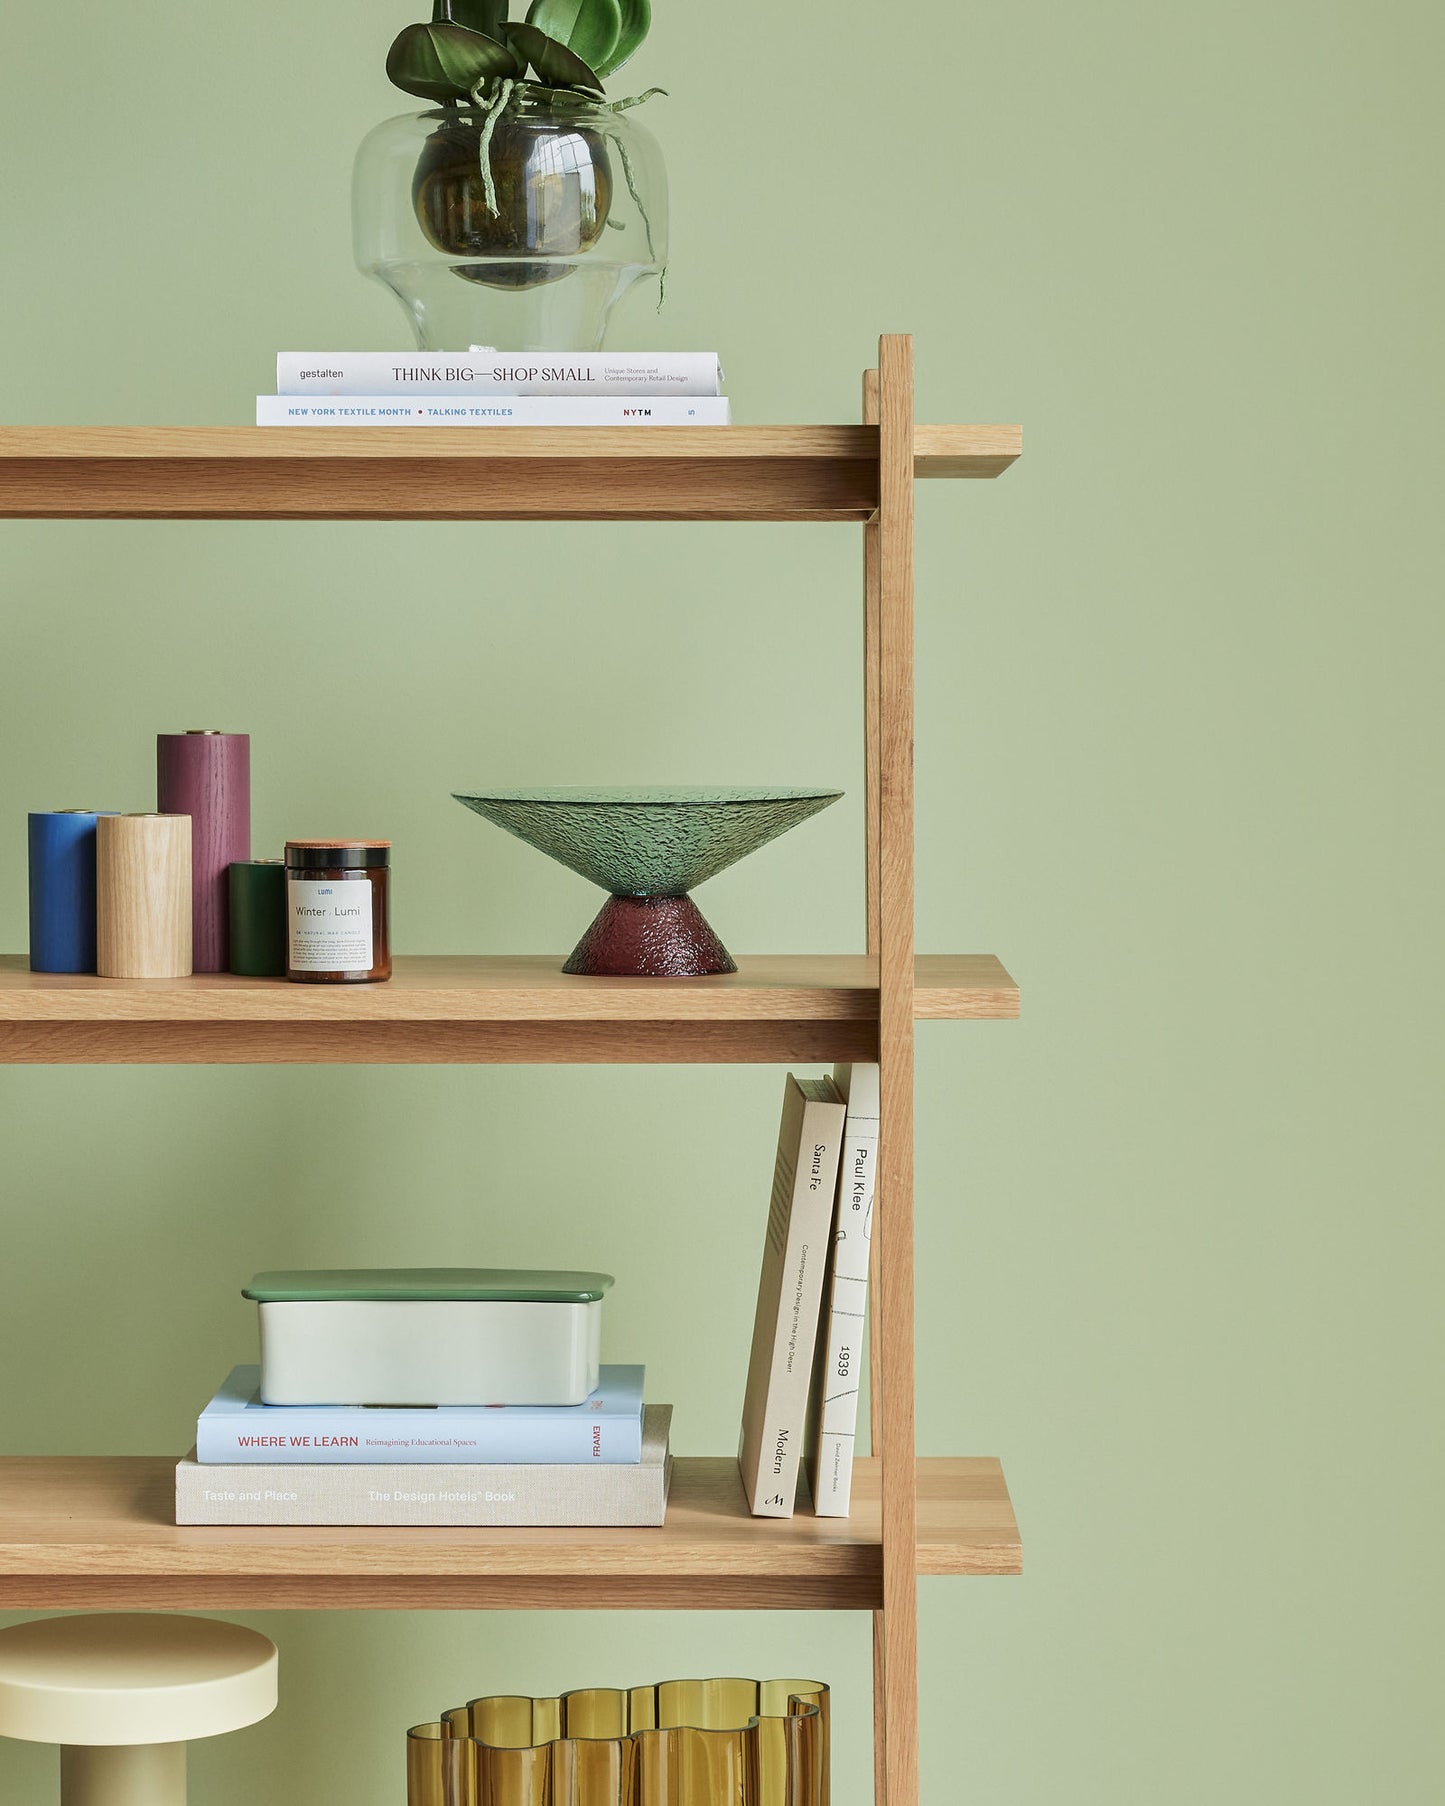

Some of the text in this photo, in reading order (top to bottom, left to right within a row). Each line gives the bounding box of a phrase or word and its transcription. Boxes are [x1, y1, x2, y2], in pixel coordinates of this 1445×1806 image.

[299, 369, 344, 380] gestalten
[392, 367, 442, 381] THINK
[541, 367, 595, 382] SMALL
[604, 367, 625, 375] Unique
[604, 374, 689, 383] Contemporary Retail Design
[288, 408, 513, 416] NEW YORK TEXTILE MONTH TALKING TEXTILES
[296, 906, 360, 916] Winter Lumi
[809, 1143, 826, 1191] Santa Fe
[852, 1148, 868, 1211] Paul Klee
[796, 1244, 809, 1291] Contemporary
[793, 1292, 803, 1314] Design
[788, 1334, 797, 1351] High
[787, 1351, 795, 1373] Desert
[837, 1345, 850, 1377] 1939
[238, 1436, 359, 1447] WHERE WE LEARN
[365, 1438, 477, 1448] Reimagining Educational Spaces
[773, 1428, 790, 1474] Modern
[203, 1490, 298, 1501] Taste and Place
[368, 1491, 390, 1501] The
[394, 1491, 435, 1504] Design
[485, 1491, 515, 1502] Book
